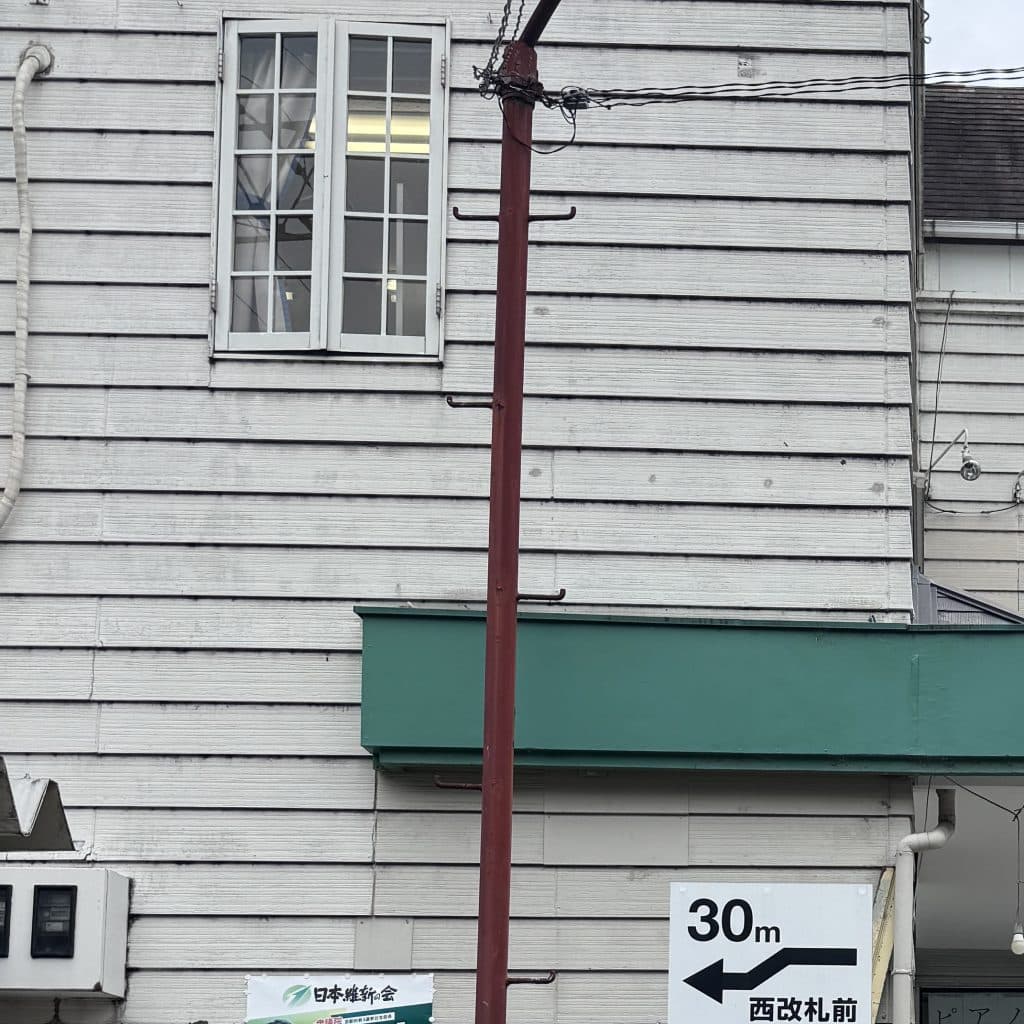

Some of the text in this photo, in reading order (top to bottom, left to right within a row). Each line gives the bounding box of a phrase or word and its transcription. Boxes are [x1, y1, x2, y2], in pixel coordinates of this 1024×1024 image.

[687, 898, 781, 943] 30m
[313, 984, 397, 1005] 日本維新の会
[749, 997, 858, 1023] 西改札前
